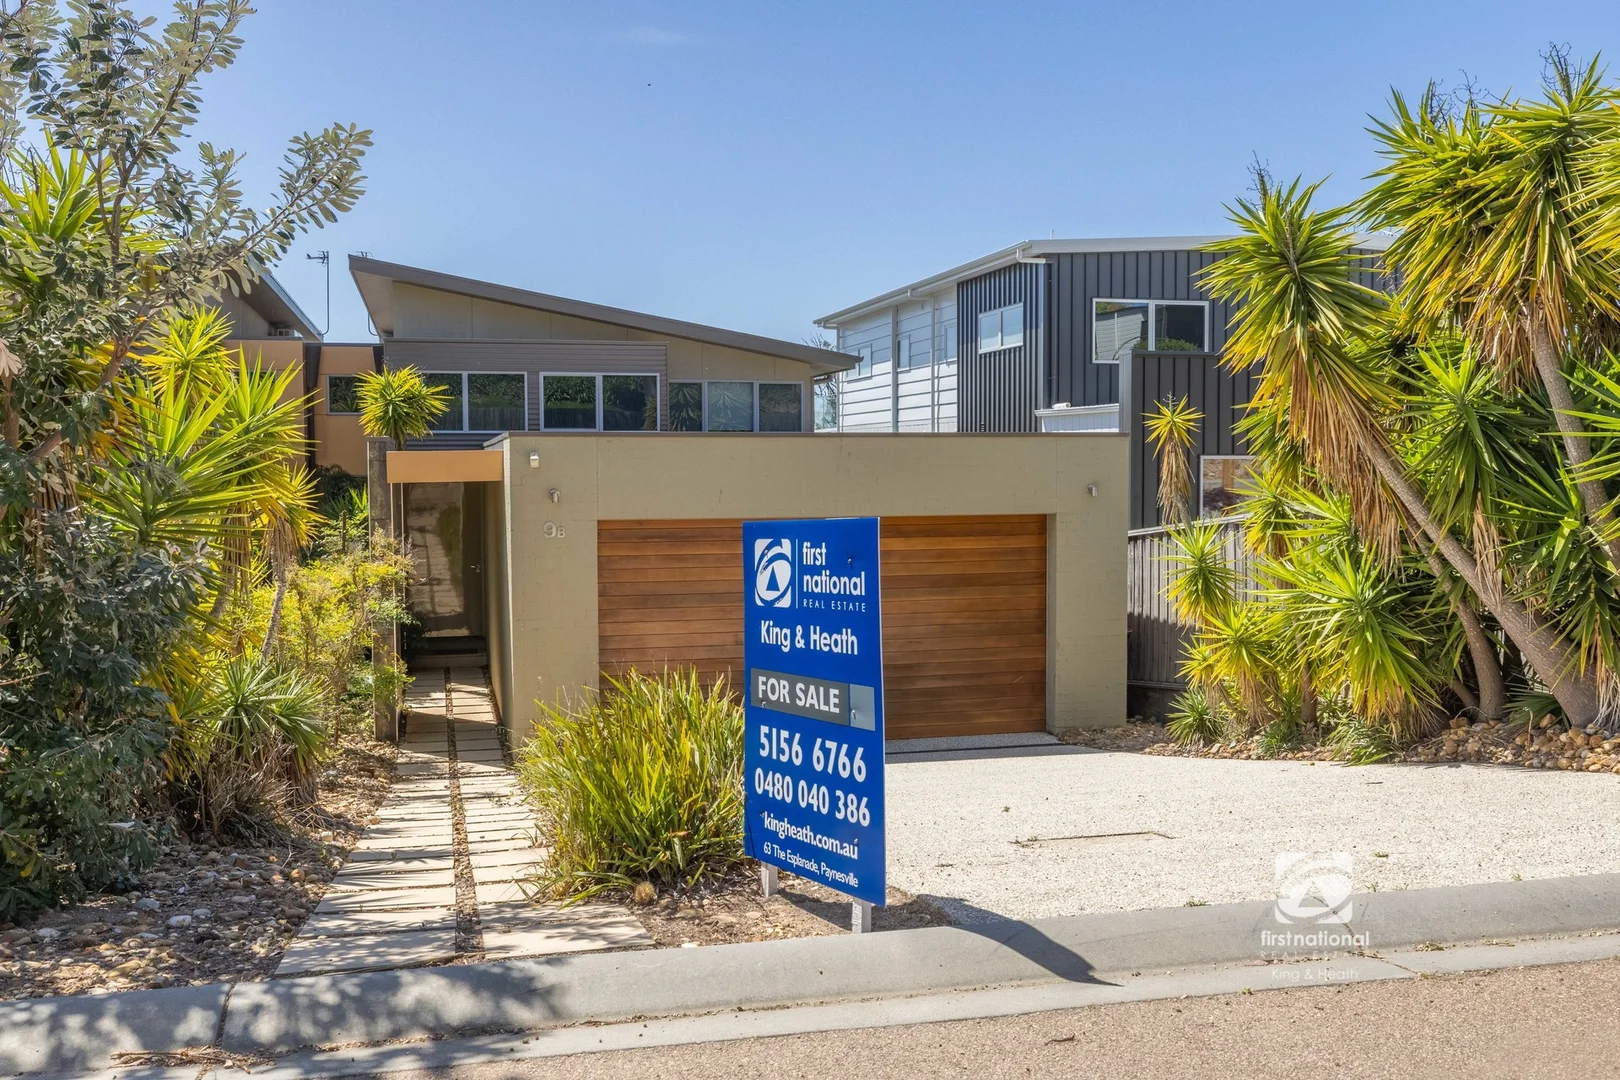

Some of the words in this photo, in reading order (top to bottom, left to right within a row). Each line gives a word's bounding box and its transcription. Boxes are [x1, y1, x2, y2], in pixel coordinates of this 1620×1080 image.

[543, 521, 566, 538] 9B
[802, 541, 827, 566] first
[803, 570, 866, 596] national
[803, 599, 825, 609] REAL
[831, 600, 866, 612] ESTATE
[760, 620, 791, 653] King
[795, 625, 805, 649] &
[810, 625, 858, 655] Heath
[758, 675, 790, 704] FOR
[795, 682, 840, 714] SALE
[759, 725, 803, 766] 5156
[812, 737, 867, 782] 6766
[755, 767, 793, 804] 0480
[798, 780, 829, 815] 040
[835, 790, 871, 827] 386
[764, 811, 859, 860] kingheath.com.au
[763, 842, 772, 854] 63
[773, 844, 786, 861] The
[786, 850, 820, 875] Esplanade,
[821, 862, 859, 888] Paynesville
